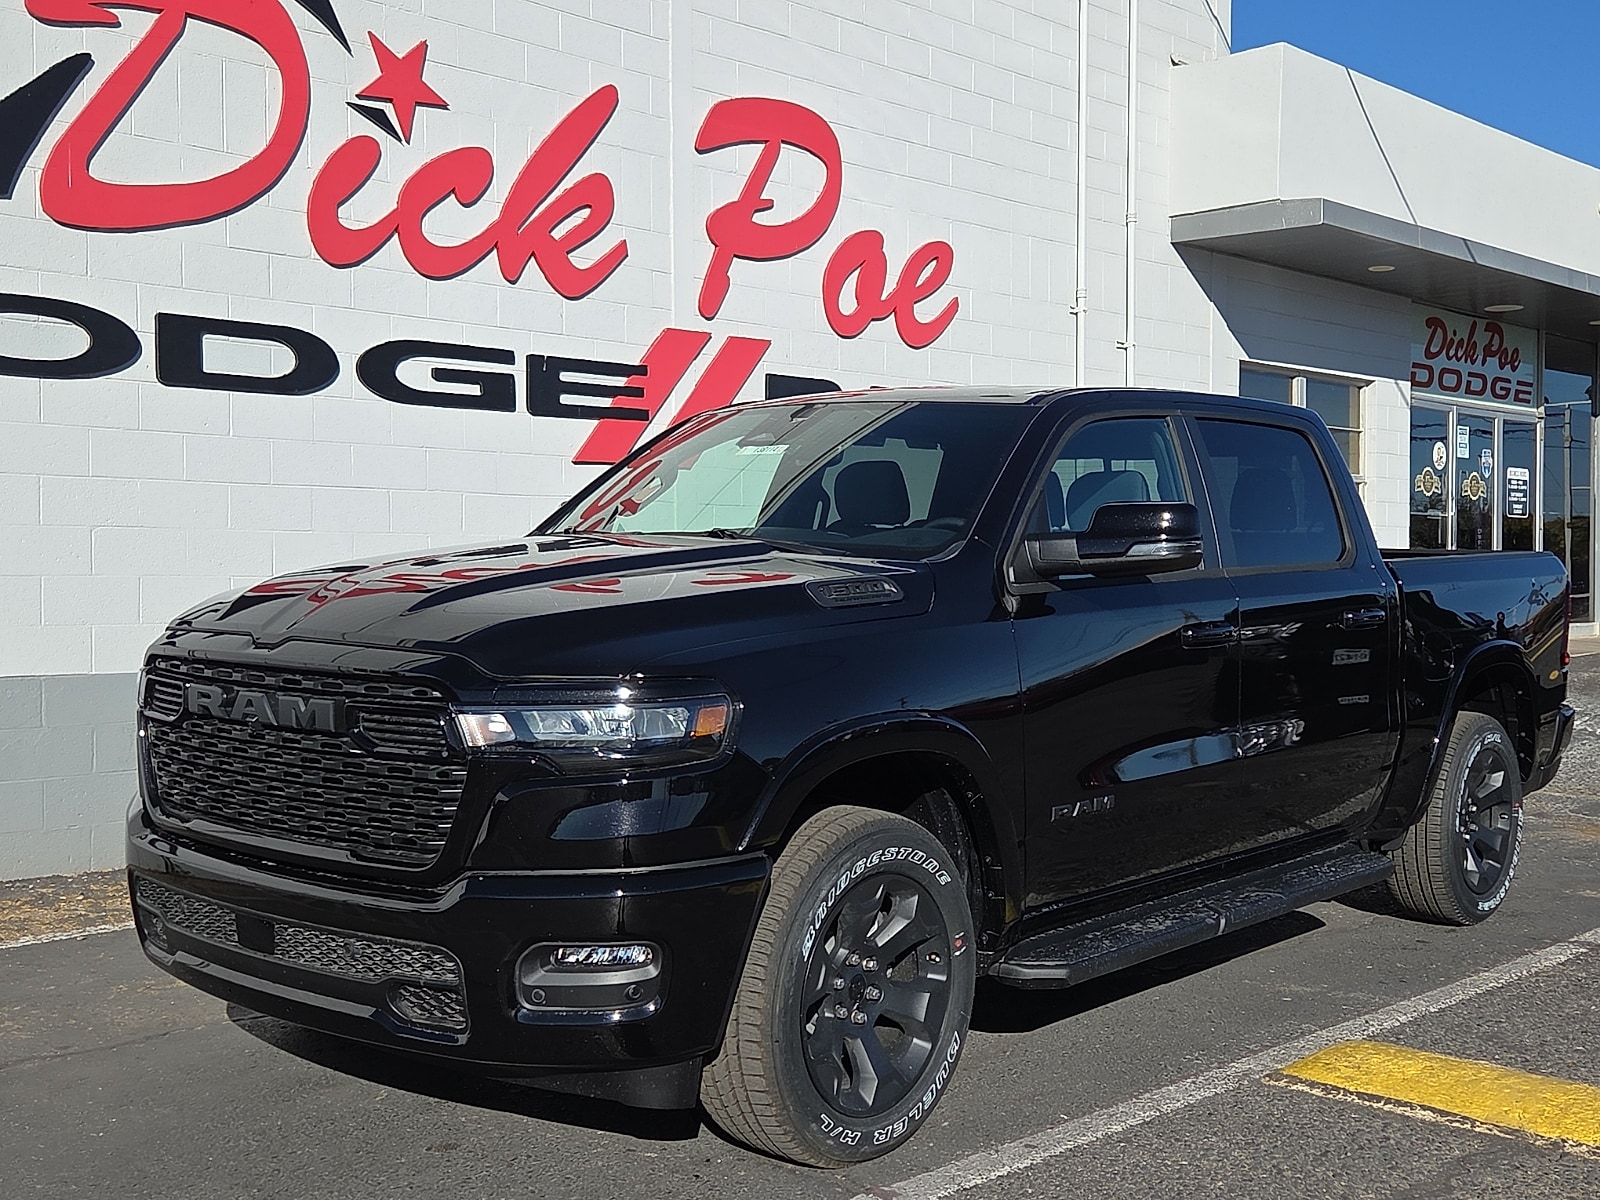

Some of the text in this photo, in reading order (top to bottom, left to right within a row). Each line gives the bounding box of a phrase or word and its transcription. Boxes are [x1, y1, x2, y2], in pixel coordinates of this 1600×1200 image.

[24, 0, 960, 350] Dick Poe
[1423, 316, 1521, 373] Dick Poe
[1410, 361, 1534, 405] DODGE
[186, 682, 338, 733] RAM
[1050, 793, 1116, 823] RAM
[802, 846, 952, 963] BRIDGESTONE
[818, 1030, 962, 1146] DUELER H/L
